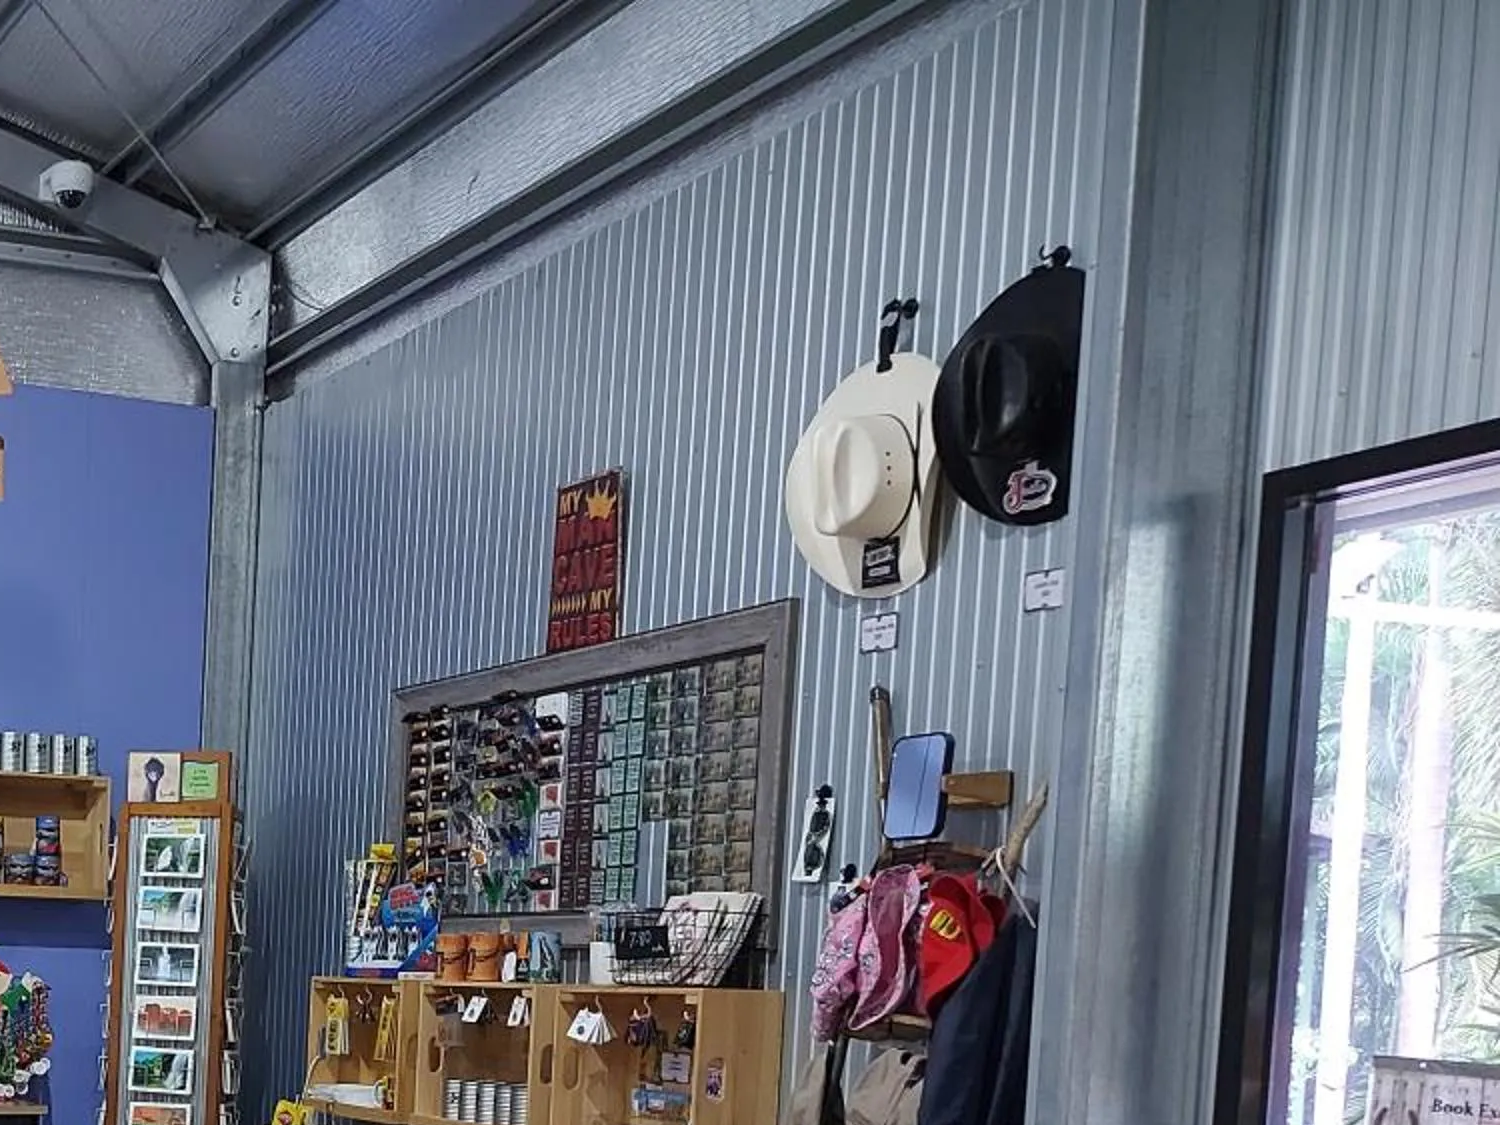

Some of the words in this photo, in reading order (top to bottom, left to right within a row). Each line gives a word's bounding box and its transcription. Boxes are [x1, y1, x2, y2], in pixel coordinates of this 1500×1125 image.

[554, 544, 615, 594] CAVE
[591, 588, 613, 611] MY
[550, 612, 613, 650] RULES
[1431, 1098, 1473, 1117] Book
